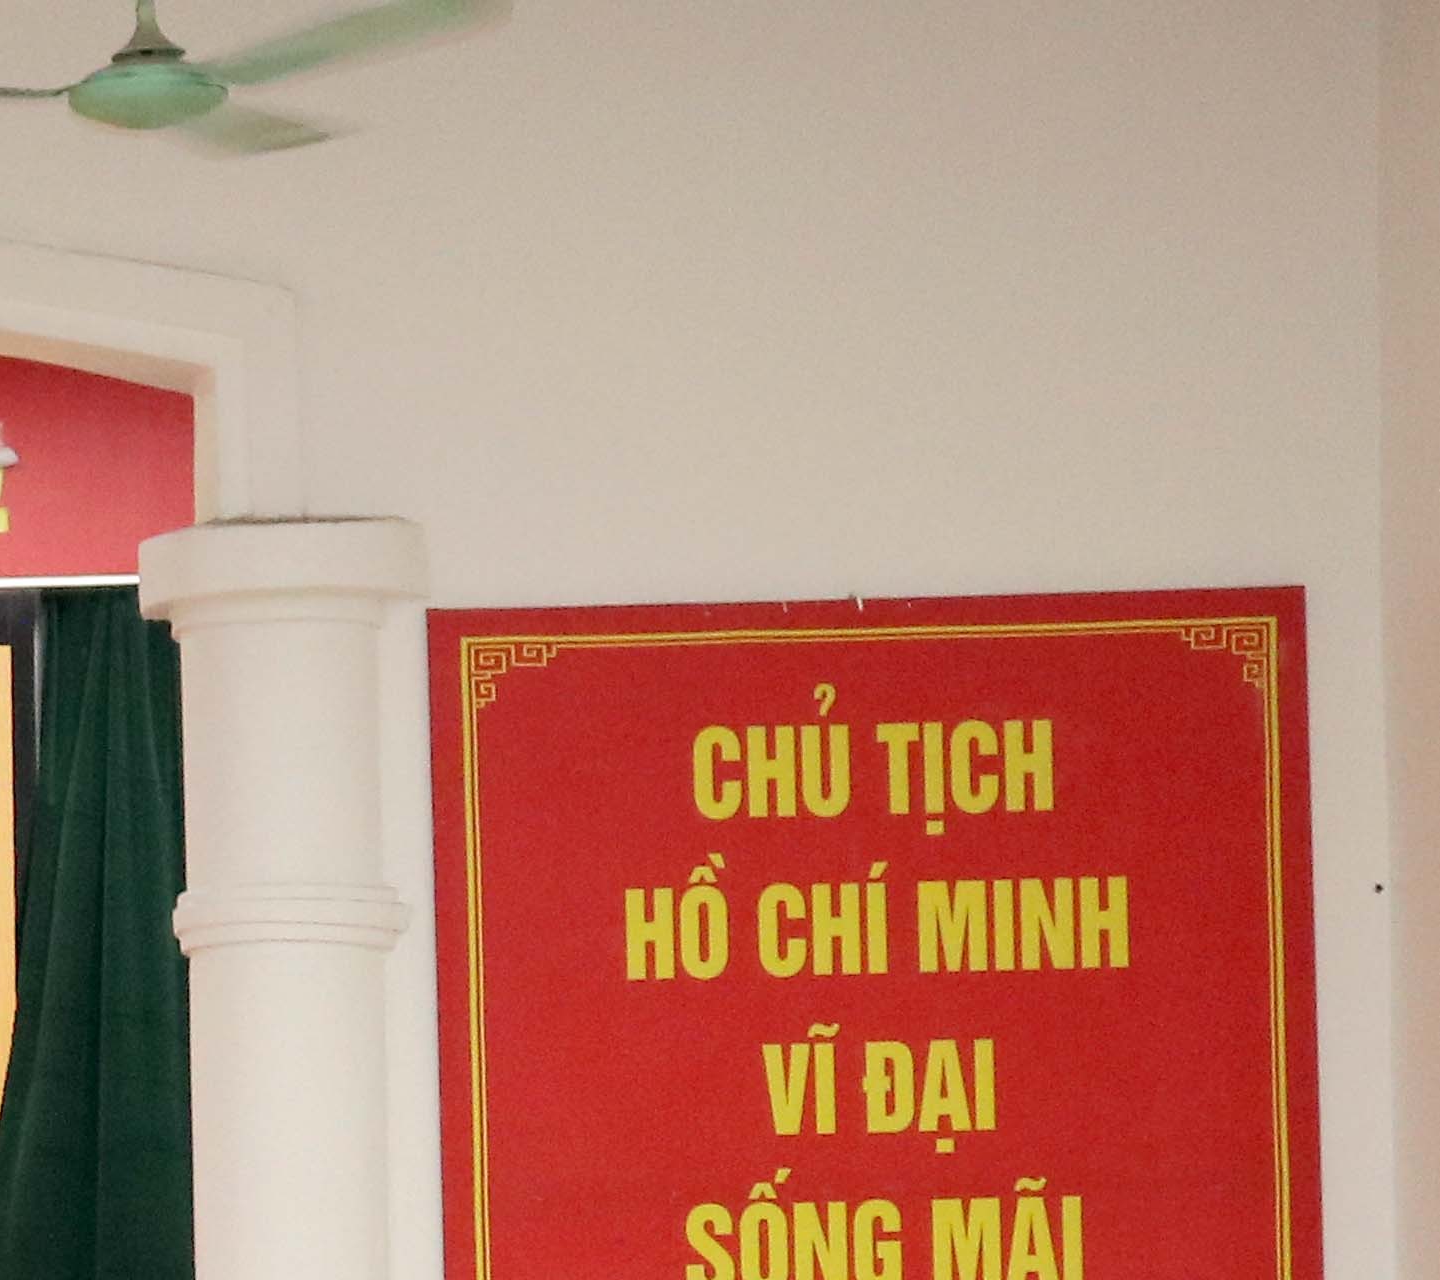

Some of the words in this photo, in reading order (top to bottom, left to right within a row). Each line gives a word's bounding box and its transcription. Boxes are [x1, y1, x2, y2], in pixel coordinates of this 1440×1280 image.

[694, 684, 849, 819] CHỦ
[877, 720, 1053, 834] TỊCH
[626, 854, 728, 979] HỒ
[758, 862, 887, 977] CHÍ
[918, 877, 1128, 972] MINH
[763, 1024, 839, 1134] VĨ
[863, 1039, 995, 1152] ĐẠI
